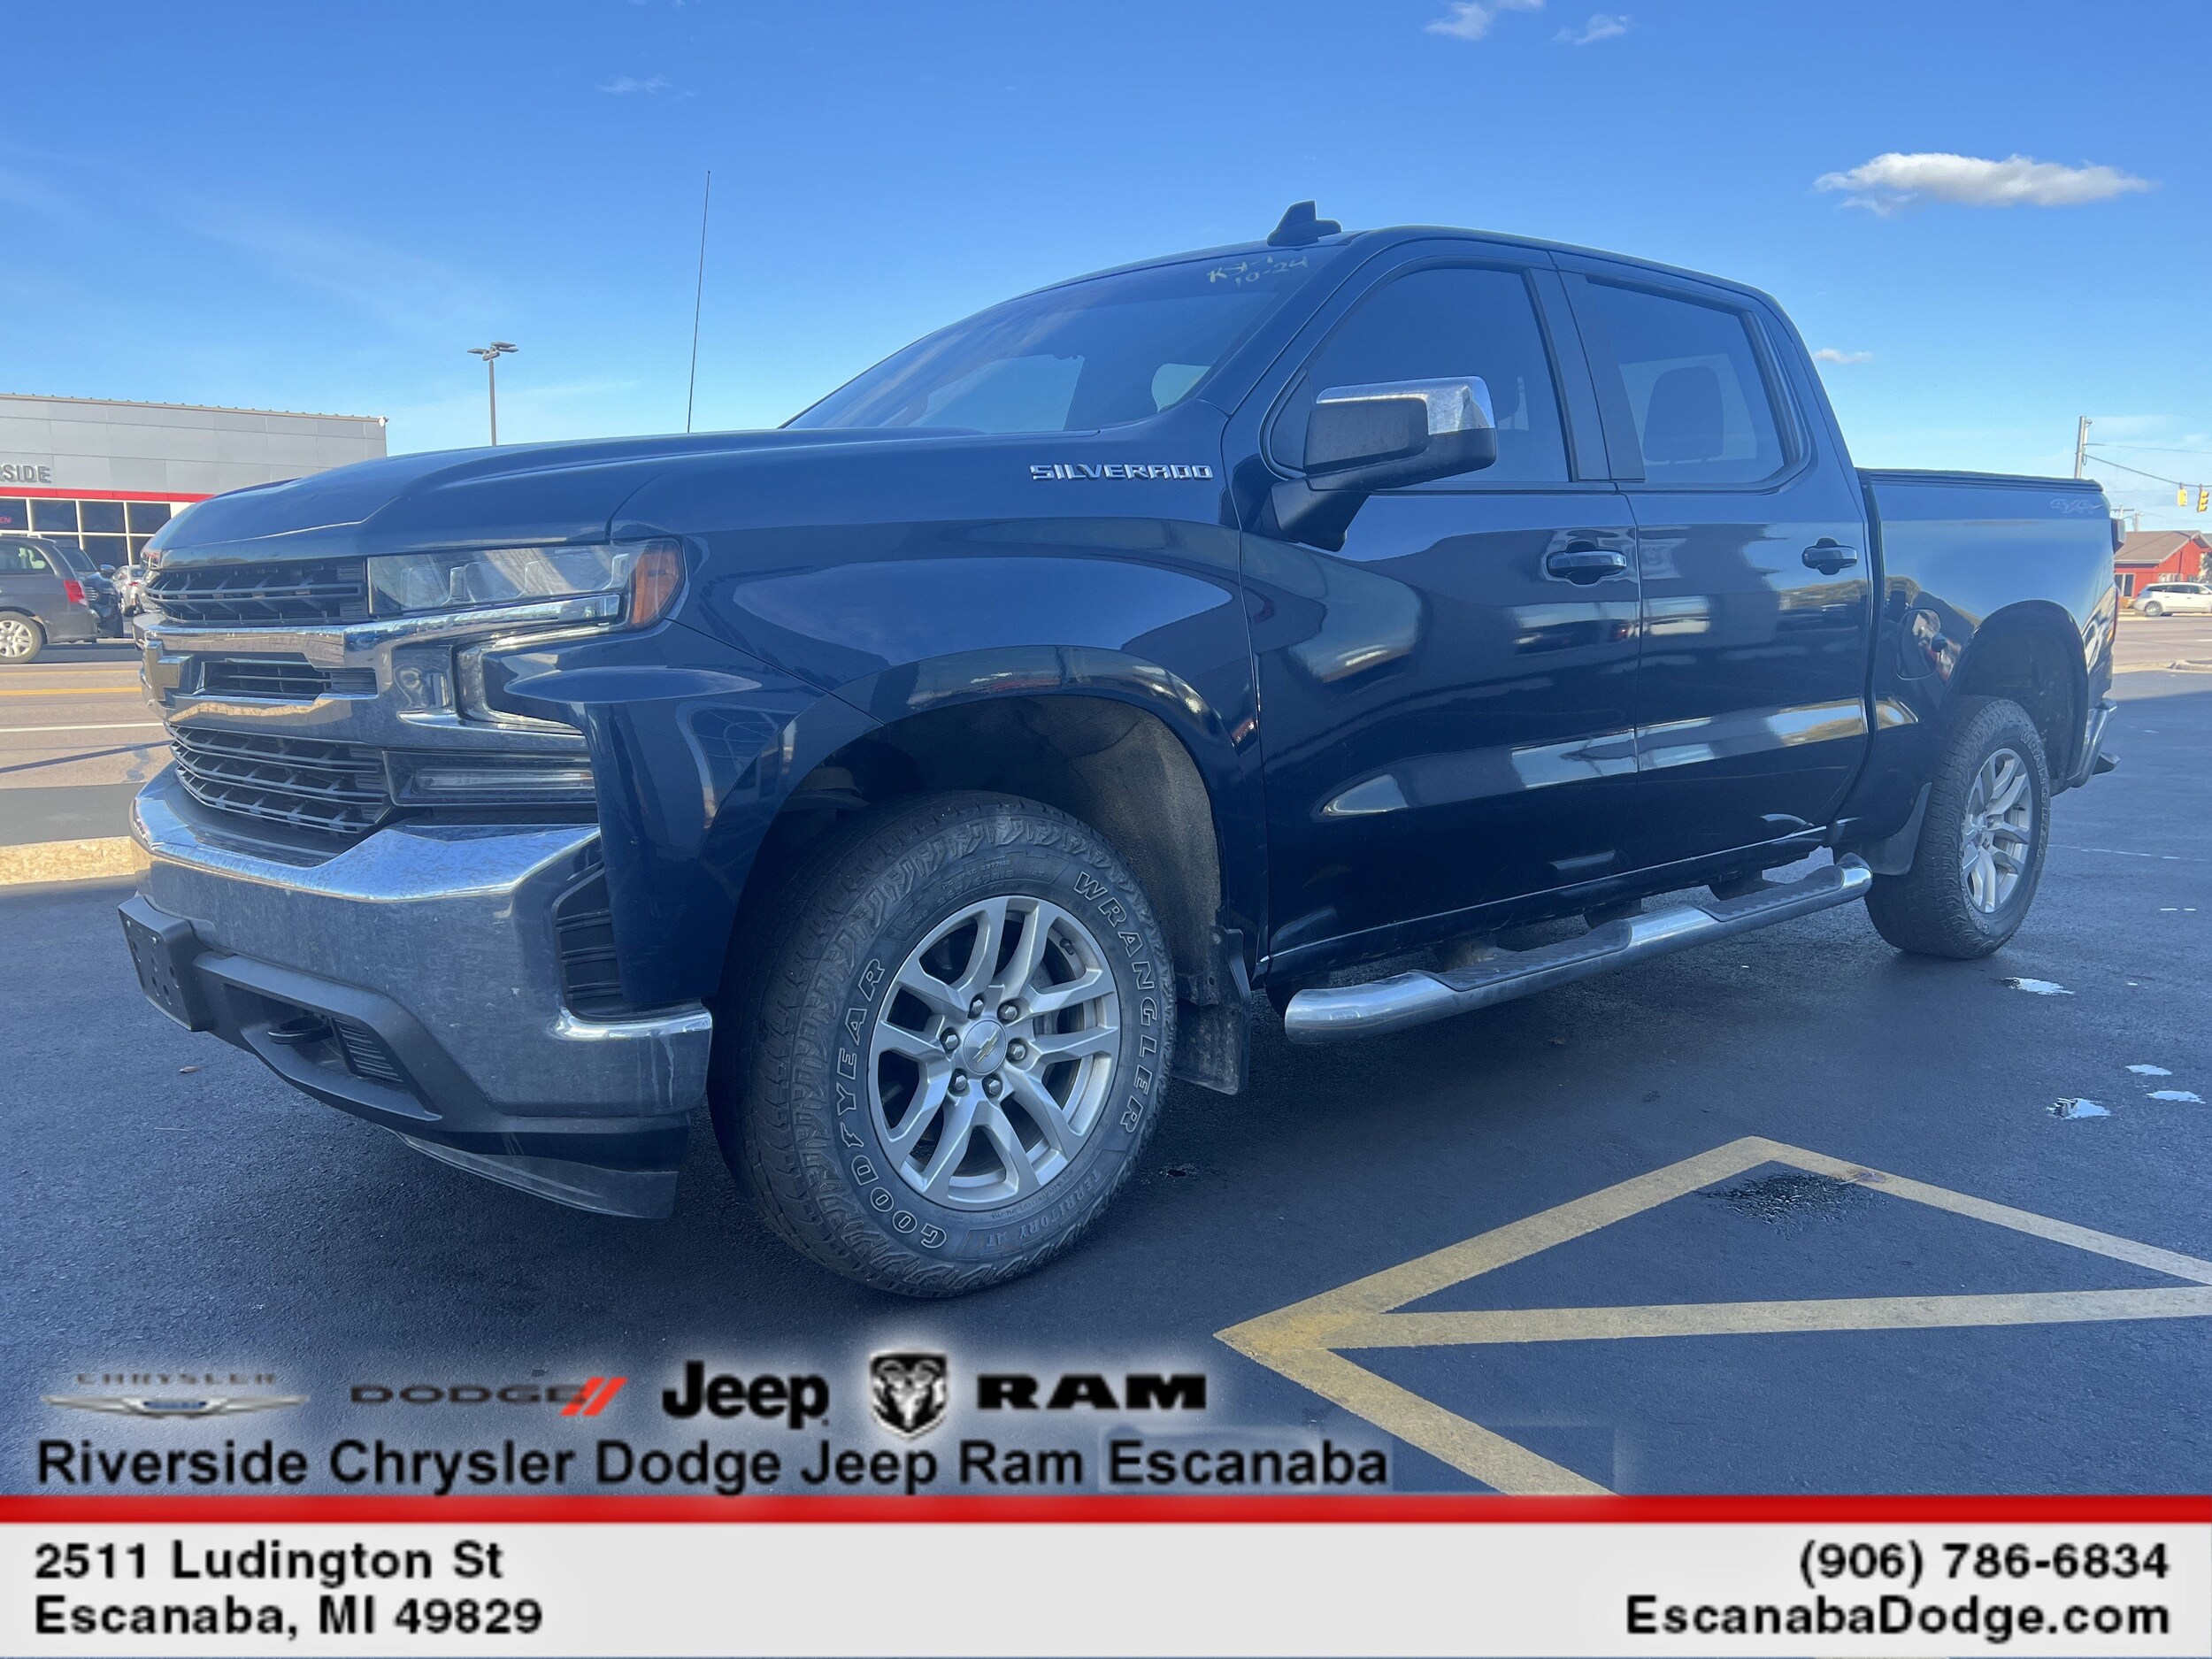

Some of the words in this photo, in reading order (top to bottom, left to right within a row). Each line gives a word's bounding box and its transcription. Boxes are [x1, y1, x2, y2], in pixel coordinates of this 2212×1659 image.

[0, 465, 51, 483] SIDE
[1029, 464, 1213, 481] SILVERADO
[2020, 728, 2047, 858] WRANGLER
[1073, 871, 1158, 1134] WRANGLER
[835, 957, 947, 1250] GOODYEAR
[986, 1231, 1007, 1248] AT
[1019, 1168, 1103, 1240] TERRITORY
